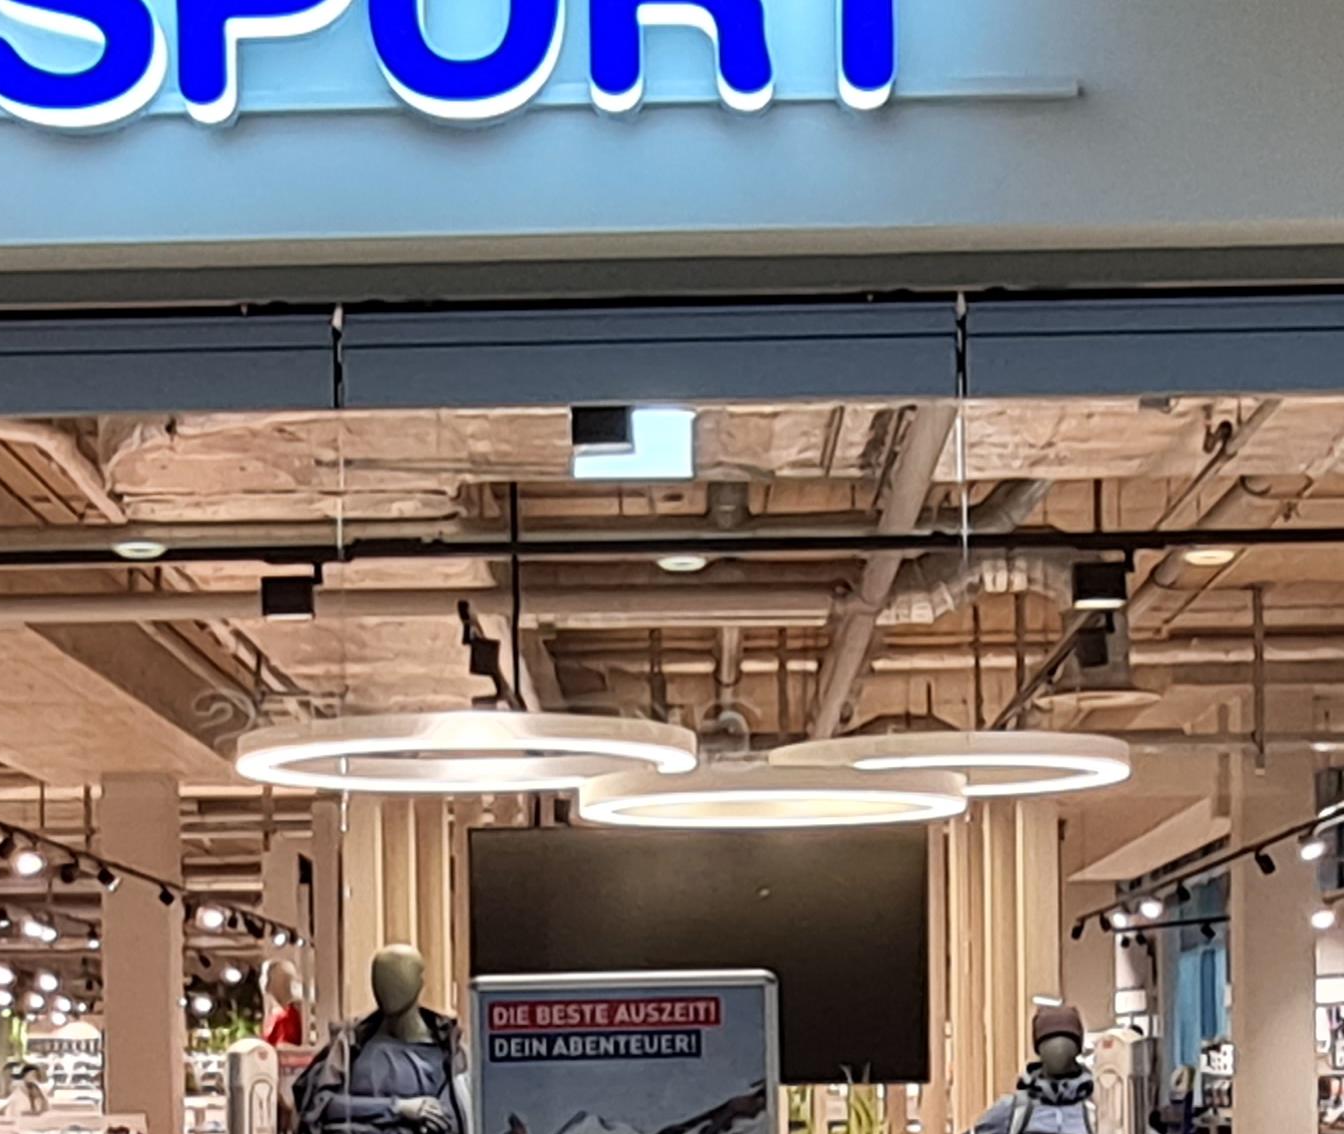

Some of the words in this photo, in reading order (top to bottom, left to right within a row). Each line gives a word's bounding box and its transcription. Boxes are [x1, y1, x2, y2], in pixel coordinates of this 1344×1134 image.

[492, 1004, 531, 1027] DIE
[535, 1003, 610, 1026] BESTE
[613, 1001, 717, 1024] AUSZEIT!
[494, 1037, 548, 1058] DEIN
[552, 1034, 697, 1056] ABENTEUER!
